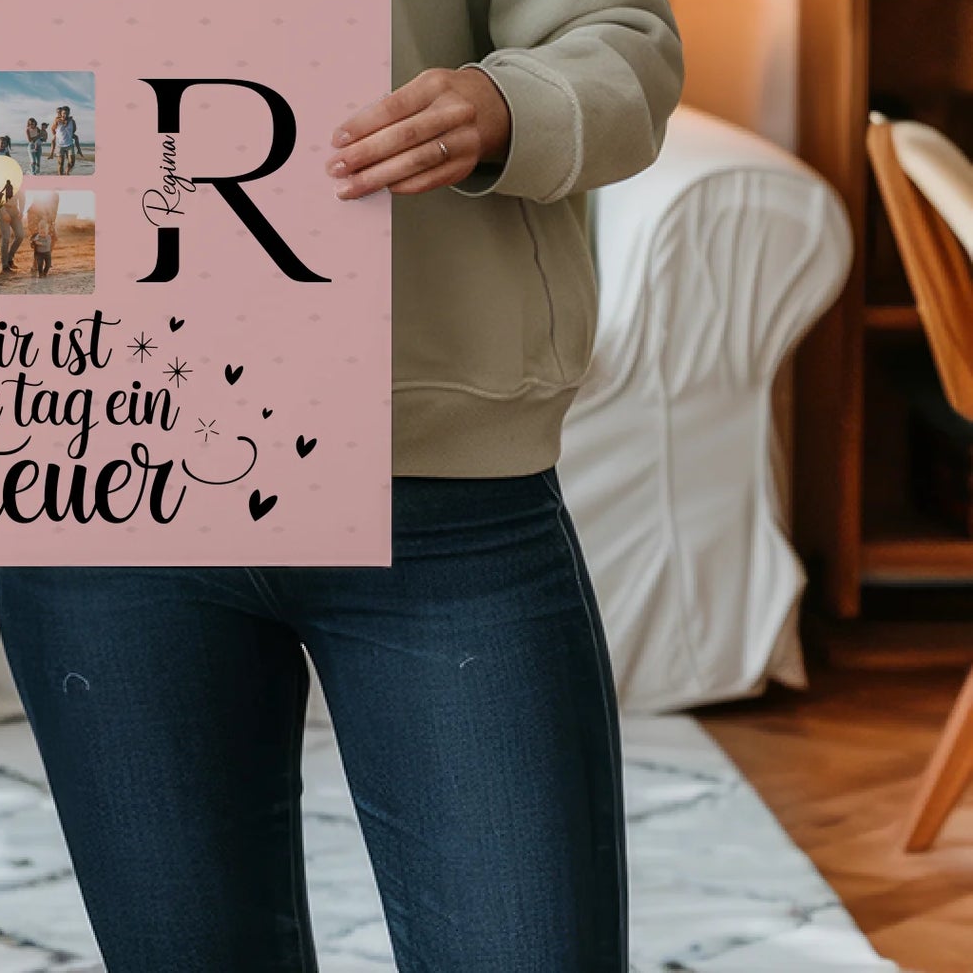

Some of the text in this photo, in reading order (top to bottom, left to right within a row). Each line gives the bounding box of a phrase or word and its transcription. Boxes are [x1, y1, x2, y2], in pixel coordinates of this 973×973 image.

[136, 78, 333, 283] R
[141, 134, 196, 227] Regina
[51, 309, 121, 376] ist
[1, 372, 100, 460] tag
[105, 380, 181, 431] ein
